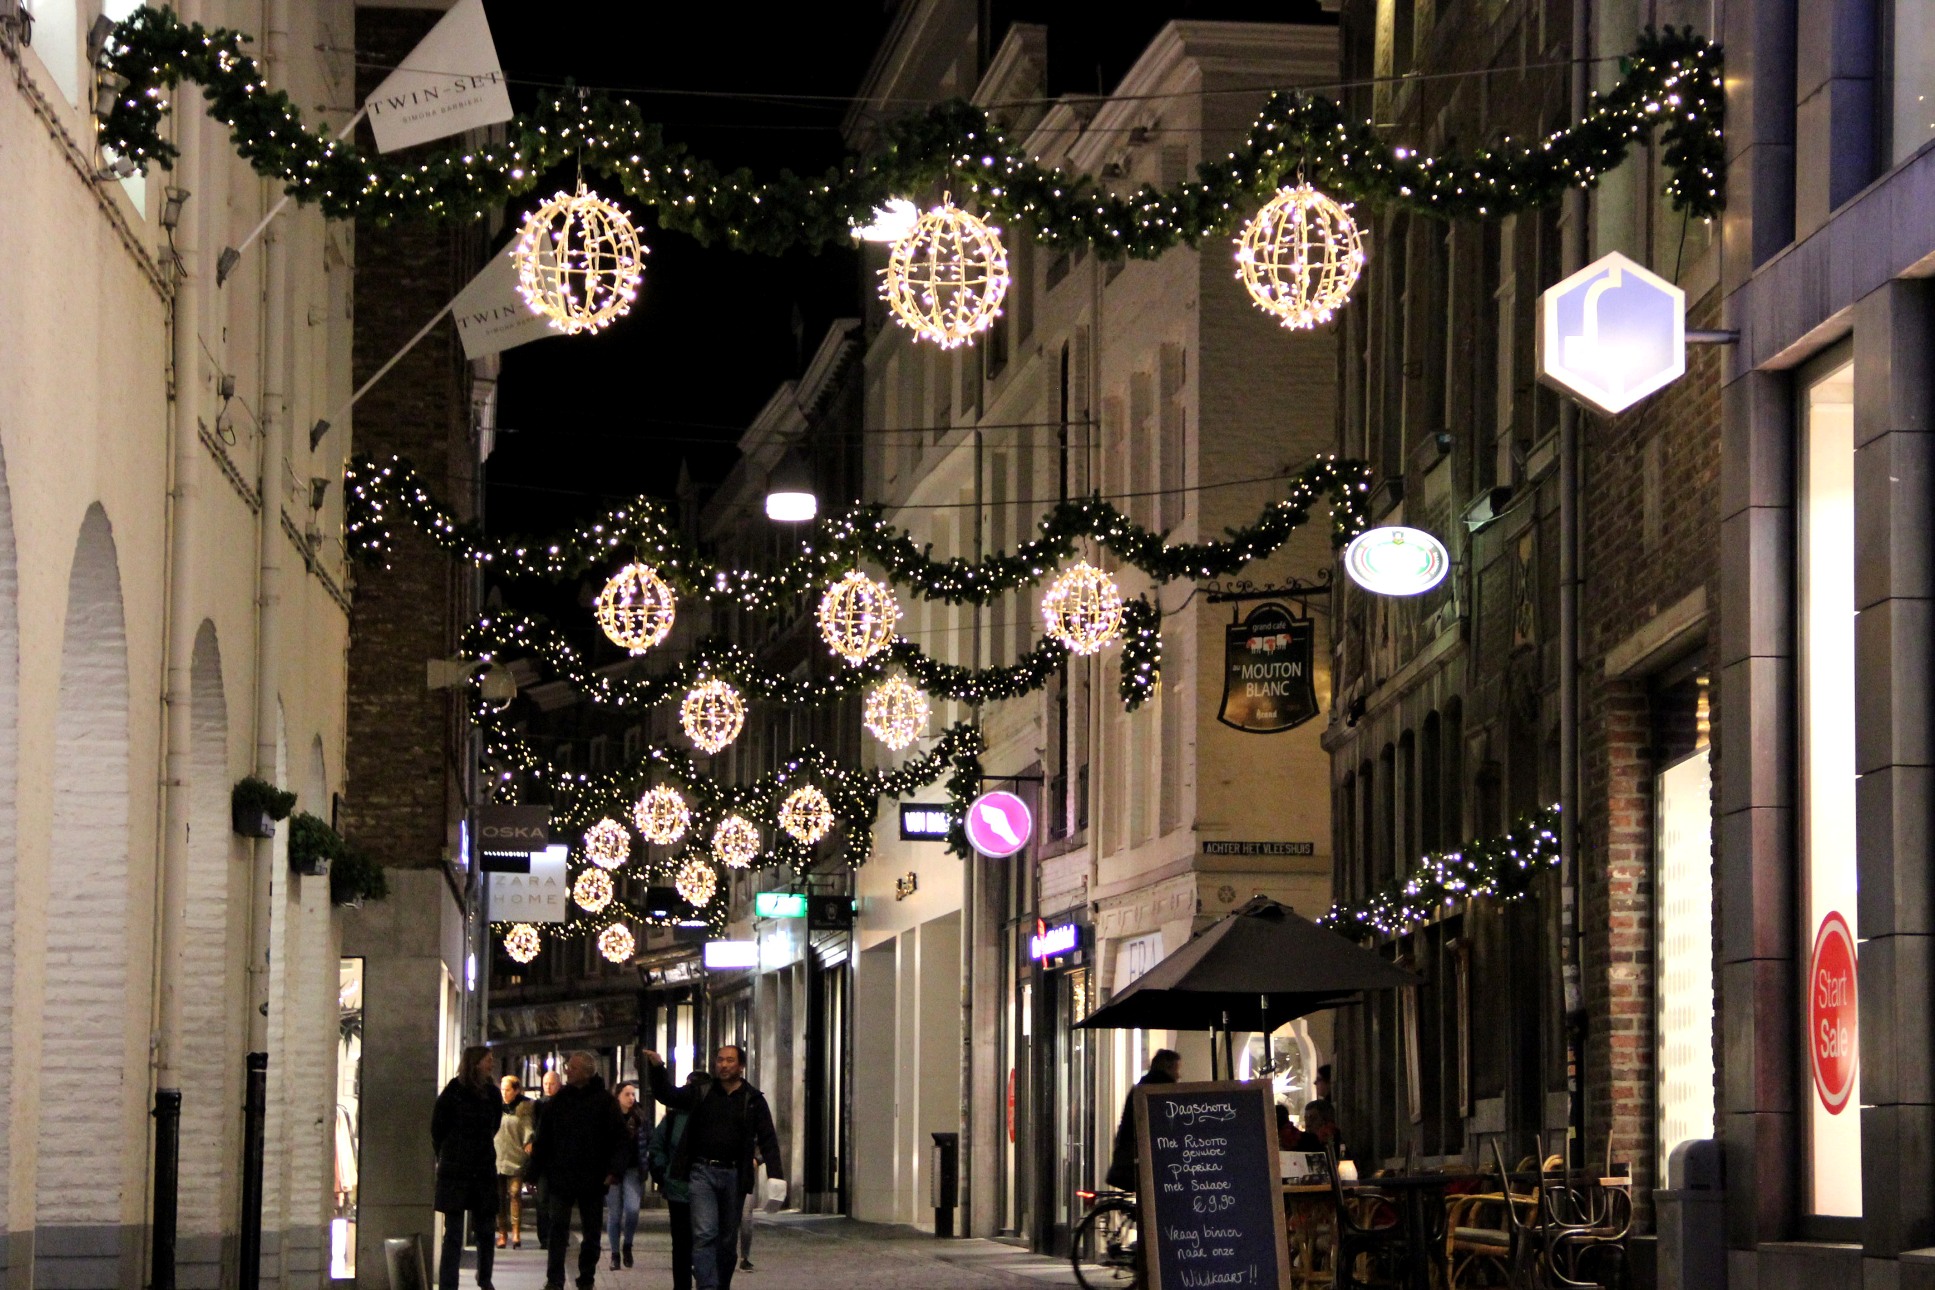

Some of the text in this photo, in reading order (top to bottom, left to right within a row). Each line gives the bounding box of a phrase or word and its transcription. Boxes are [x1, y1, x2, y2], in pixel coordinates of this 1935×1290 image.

[368, 71, 500, 115] TWIN-SET
[402, 109, 437, 123] SIMONA
[458, 303, 525, 329] TWIN-
[1252, 620, 1287, 633] grand café
[1241, 662, 1302, 679] MOUTON
[1246, 680, 1290, 698] BLANC
[482, 826, 544, 838] OSKA
[1206, 842, 1311, 854] ACHTER HET VLEESHUIS
[495, 875, 556, 886] ZARA
[493, 894, 557, 904] HOME
[1818, 968, 1847, 1009] Start
[1820, 1018, 1848, 1058] Sale
[1165, 1224, 1242, 1248] Vraag binnen
[1212, 1248, 1235, 1257] onze
